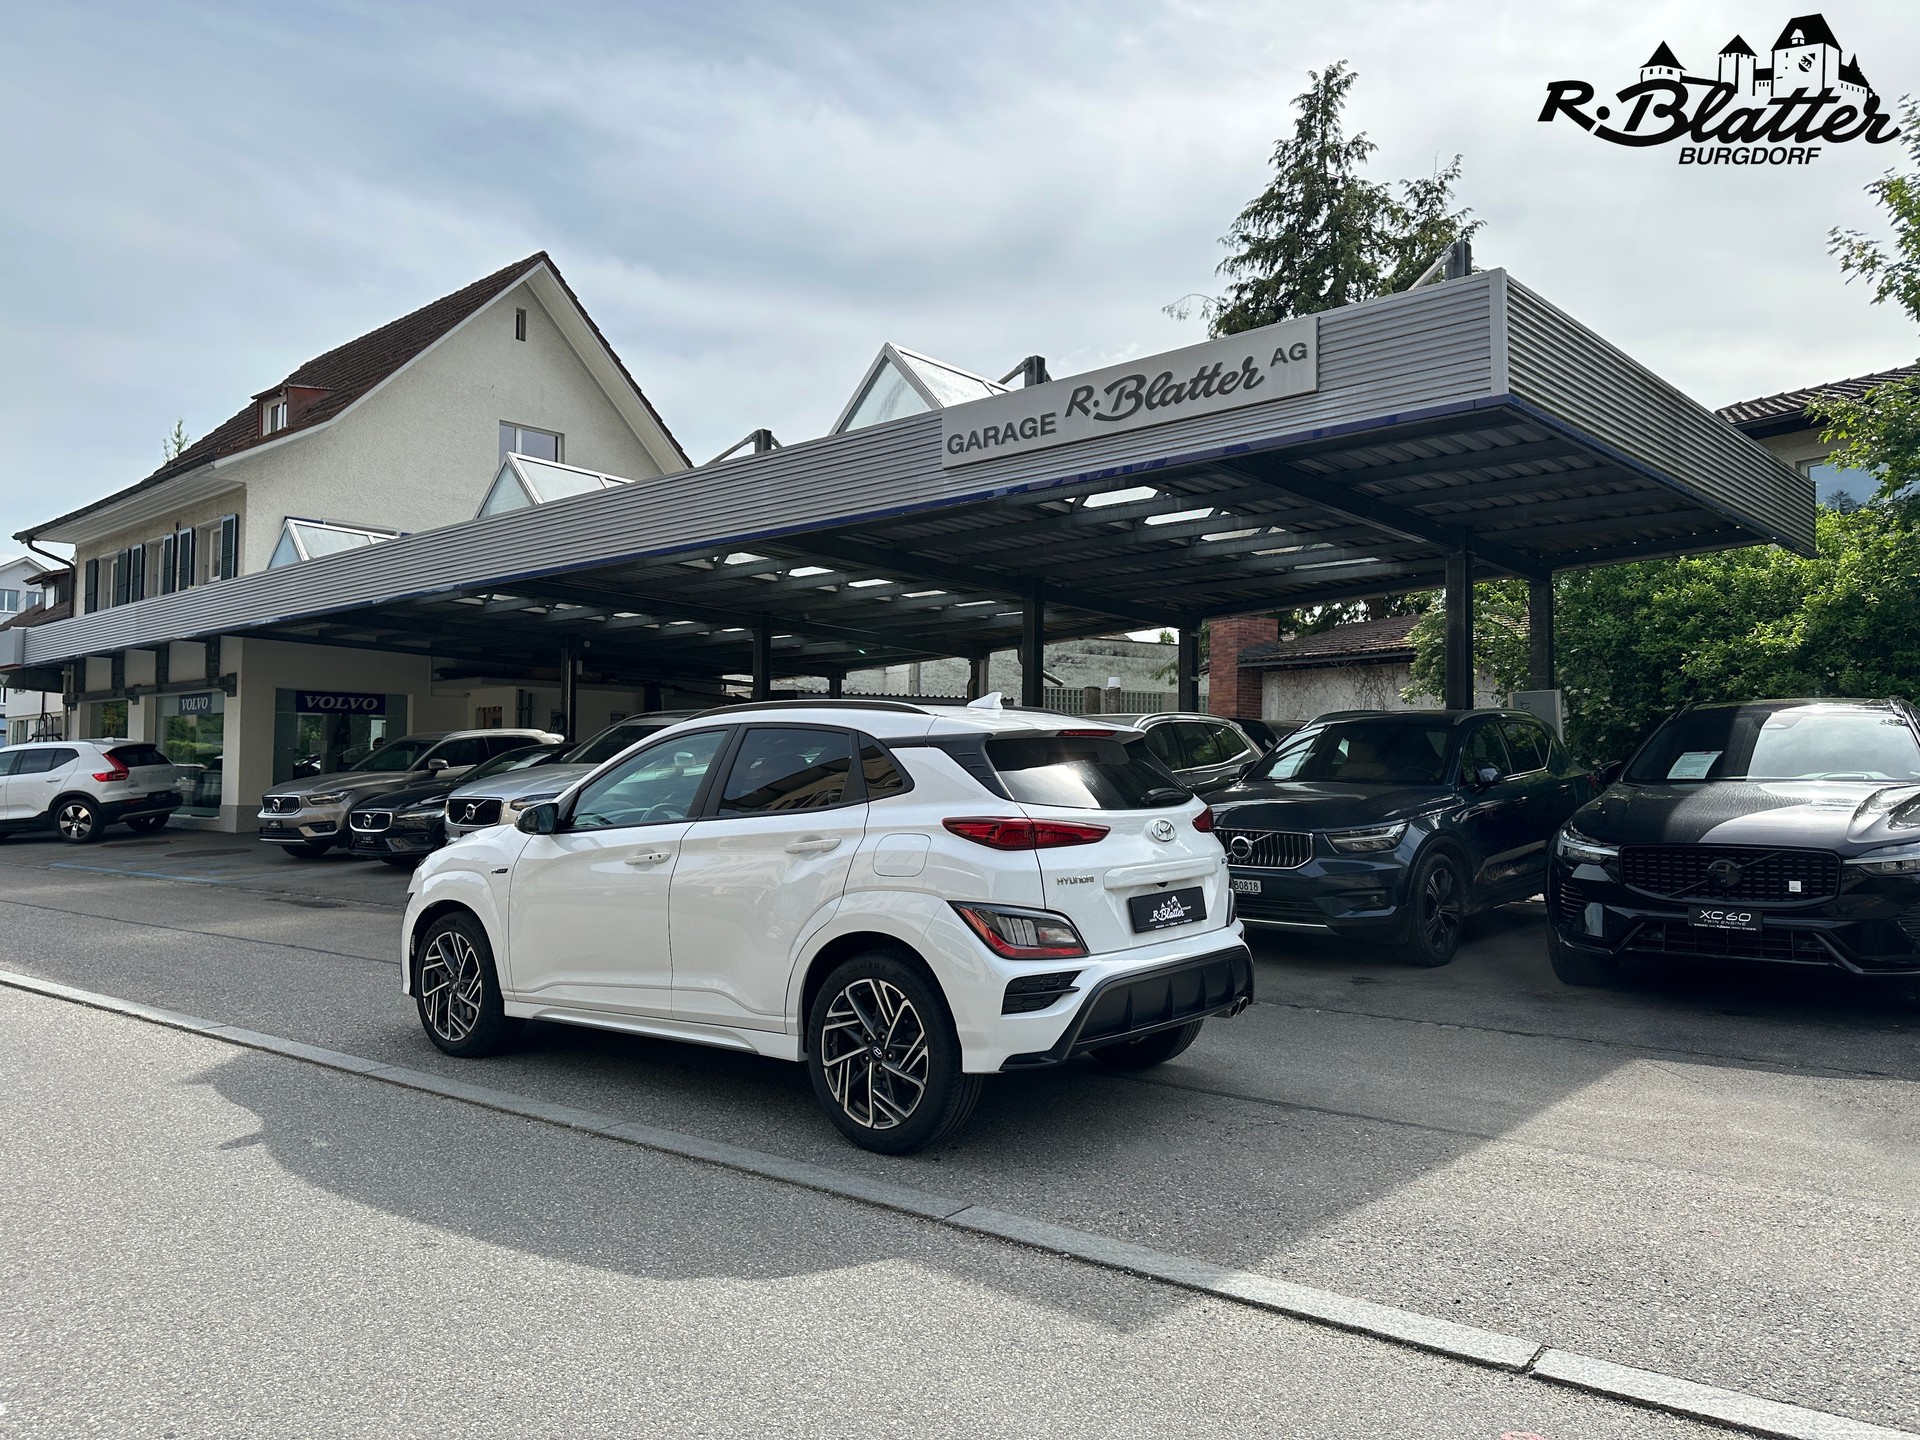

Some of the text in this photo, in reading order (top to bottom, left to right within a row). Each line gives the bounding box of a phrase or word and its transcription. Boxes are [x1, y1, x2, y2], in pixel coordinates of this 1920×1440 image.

[947, 412, 1056, 455] GARAGE
[1270, 342, 1308, 367] AG
[181, 696, 208, 711] VOLVO
[304, 695, 378, 711] VOLVO
